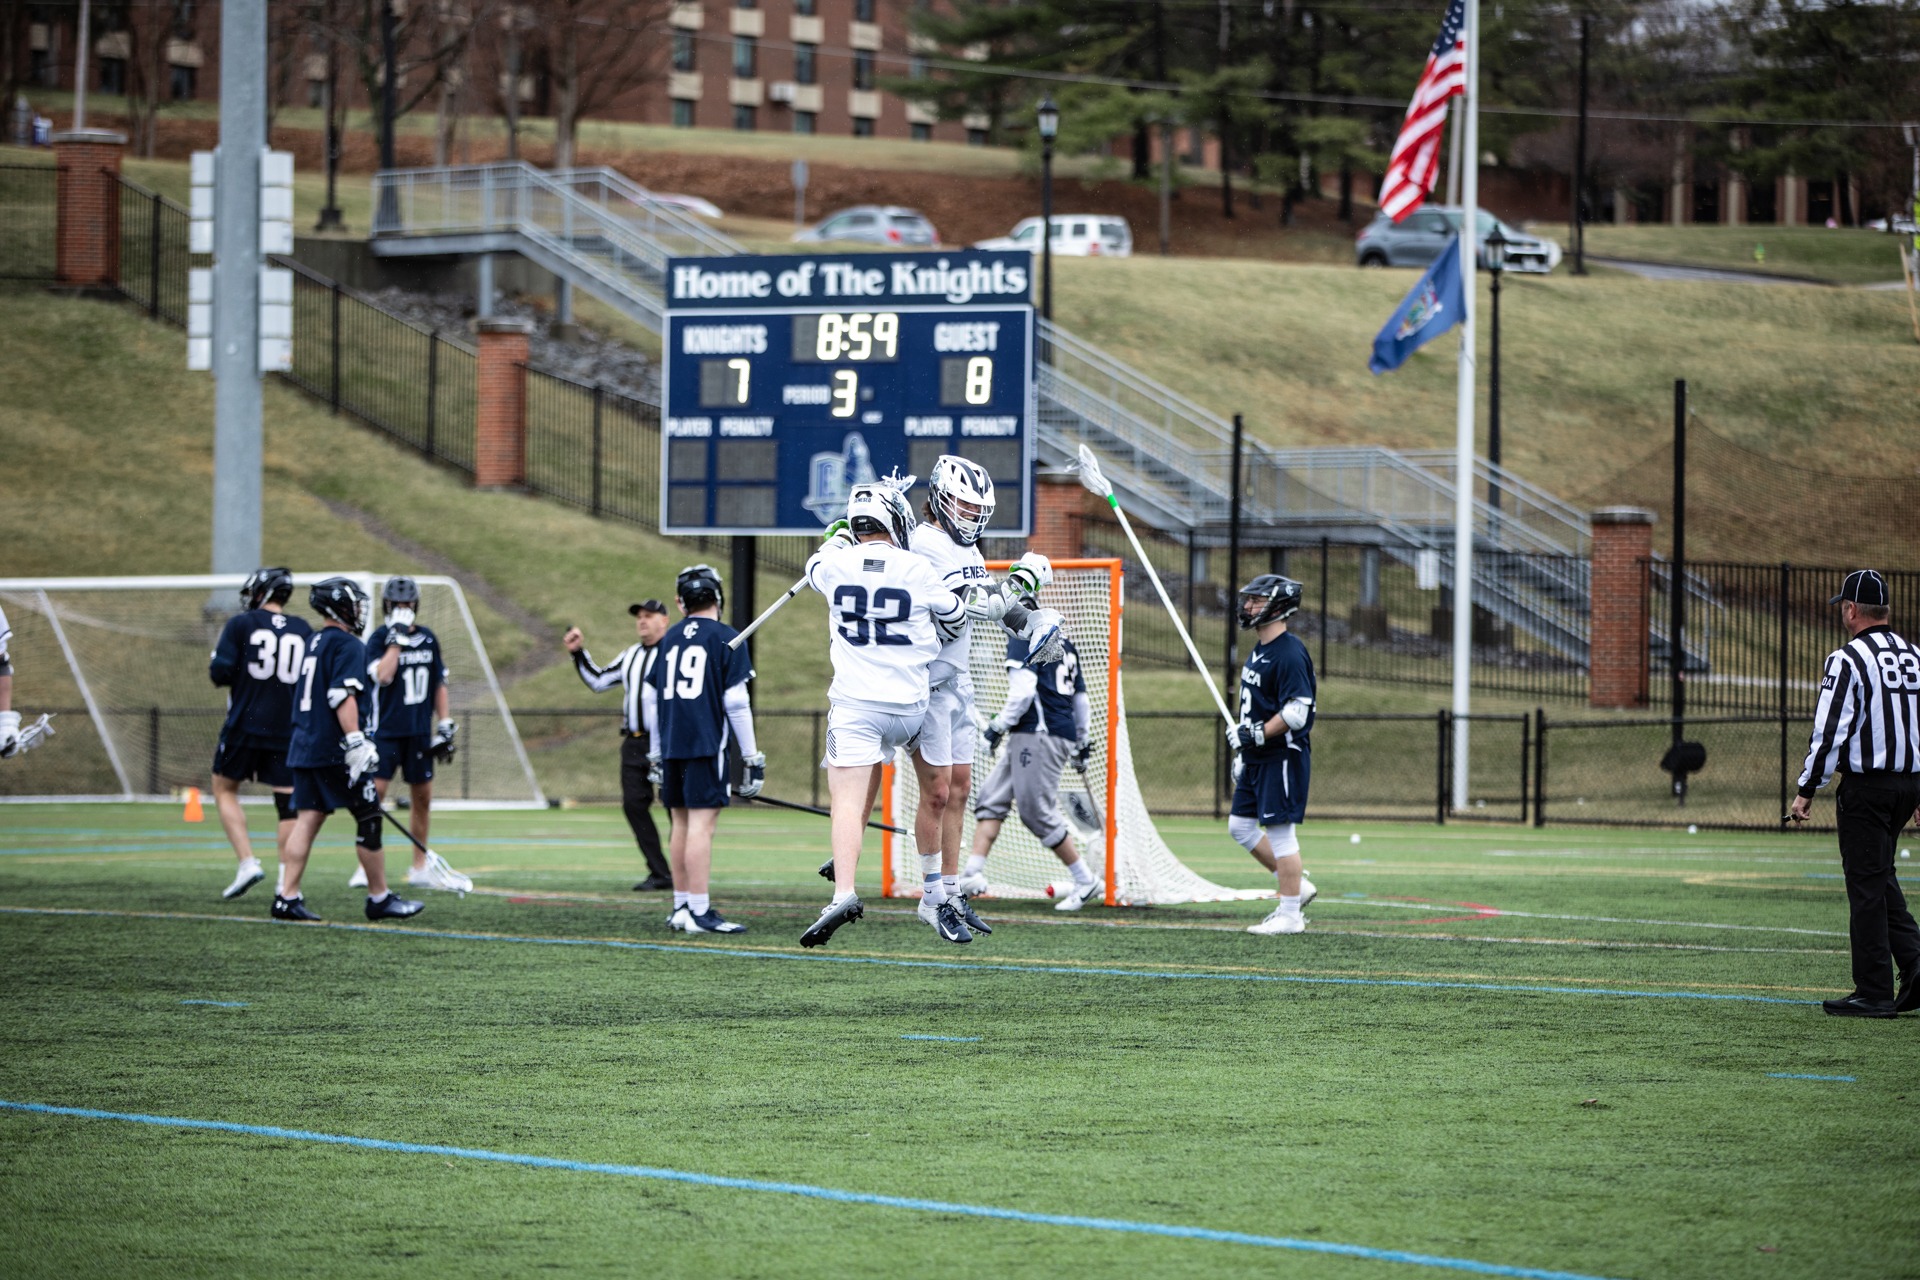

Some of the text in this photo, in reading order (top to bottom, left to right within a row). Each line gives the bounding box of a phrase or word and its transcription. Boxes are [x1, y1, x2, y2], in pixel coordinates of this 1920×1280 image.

[674, 258, 1028, 304] Home of The Knights
[683, 324, 768, 354] KNIGHTS
[816, 313, 899, 361] 8:59
[934, 321, 1000, 352] GUEST
[728, 358, 751, 404] 7
[782, 385, 831, 405] PERIOD
[832, 369, 857, 418] 3
[965, 356, 993, 405] 8
[666, 416, 774, 437] PLAYER PENALTY
[904, 415, 953, 437] PLAYER
[961, 415, 1018, 437] PENALTY
[833, 584, 913, 647] 32
[248, 628, 306, 685] 30
[663, 644, 708, 700] 19
[1876, 651, 1920, 690] 83
[301, 655, 318, 712] 7
[402, 666, 430, 705] 10
